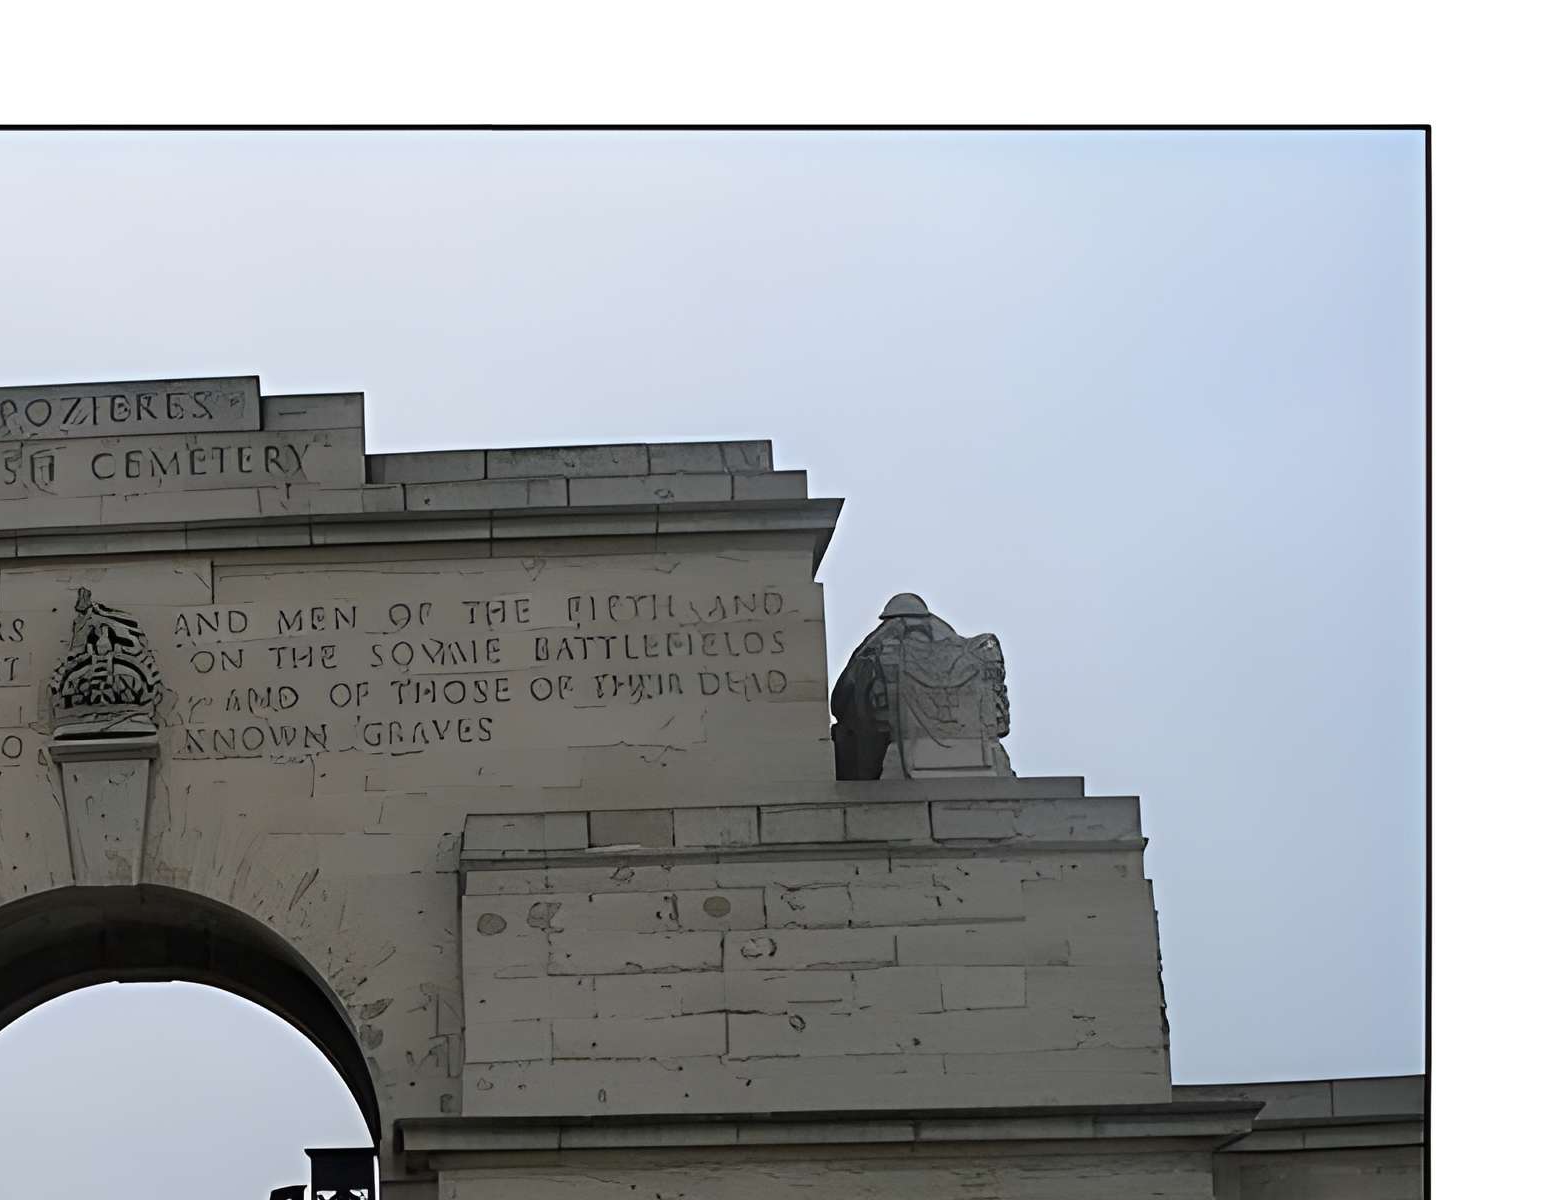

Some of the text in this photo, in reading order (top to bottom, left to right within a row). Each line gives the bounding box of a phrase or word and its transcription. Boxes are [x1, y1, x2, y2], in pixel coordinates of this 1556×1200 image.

[91, 442, 311, 482] CEMETERY
[174, 609, 248, 636] AND
[278, 605, 357, 634] MEN
[389, 602, 432, 630] OF
[462, 598, 530, 625] THE
[190, 649, 243, 673] ON
[269, 645, 337, 669] THE
[330, 682, 369, 707] OF
[391, 678, 511, 704] THOSE
